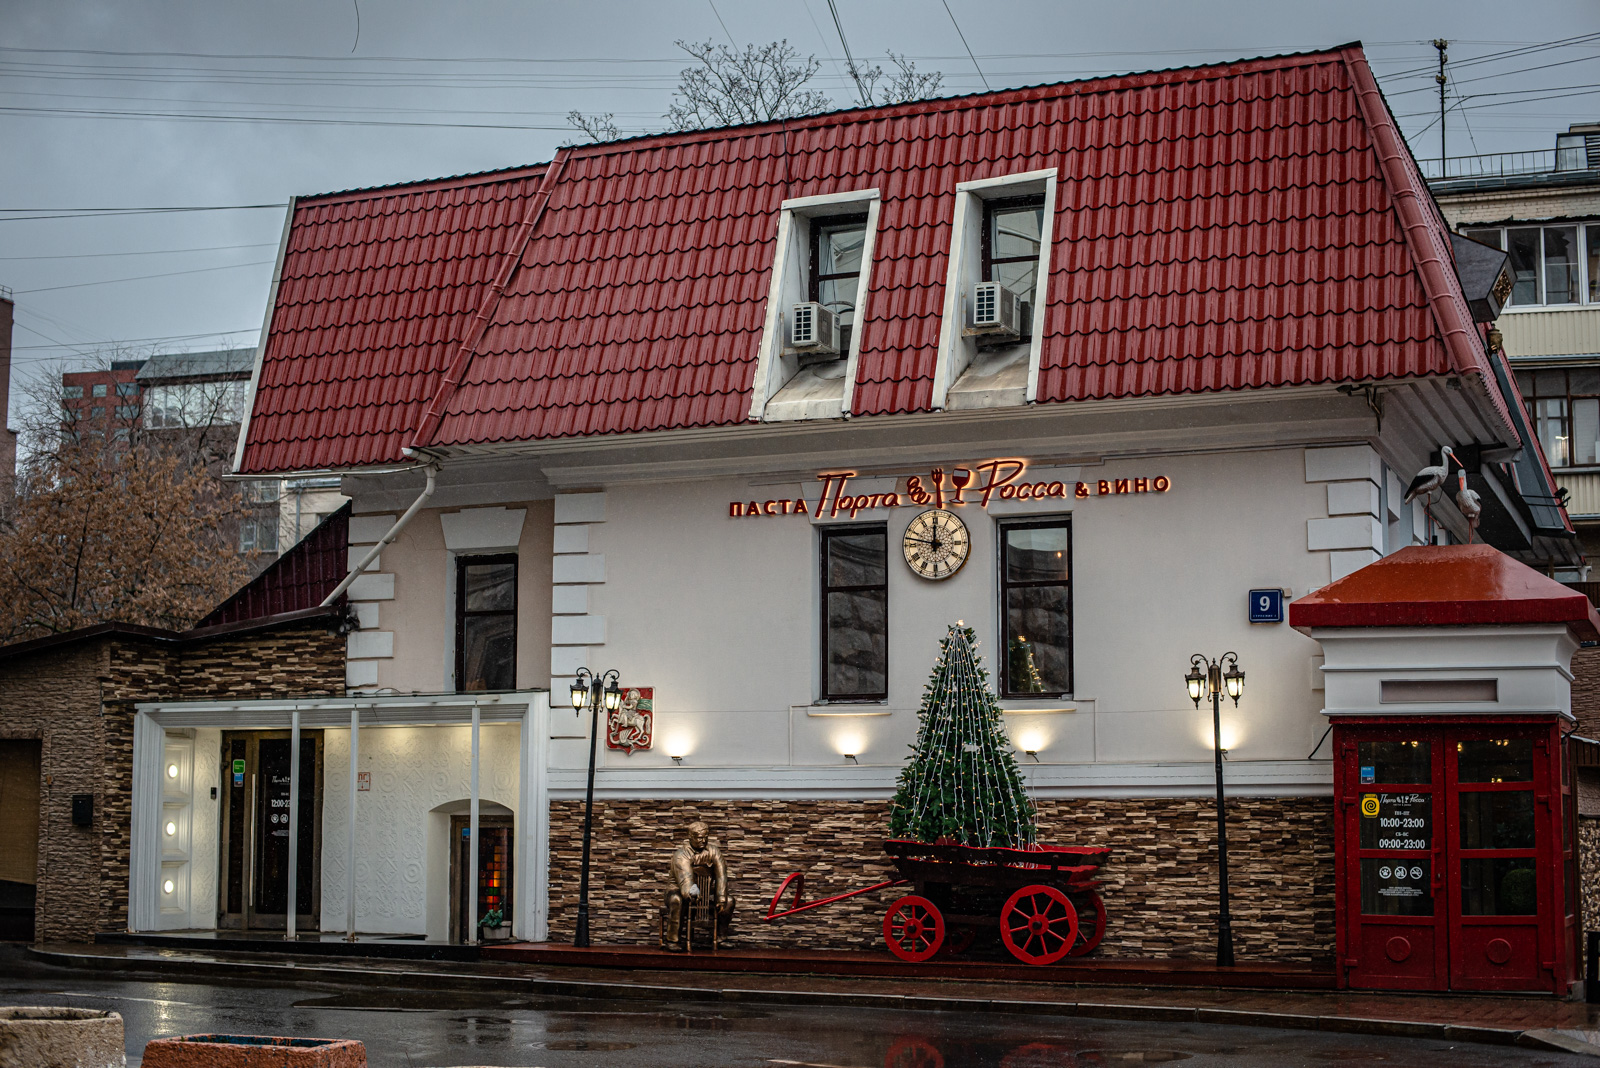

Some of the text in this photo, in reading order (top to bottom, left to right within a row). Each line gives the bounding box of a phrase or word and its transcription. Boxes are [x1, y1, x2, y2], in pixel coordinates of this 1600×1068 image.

[729, 460, 1170, 519] ПАСТА Порта Росса & ВИНО
[1259, 595, 1270, 612] 9
[1380, 817, 1425, 828] 10:00-23:00
[1379, 838, 1426, 849] 09:00-23:00
